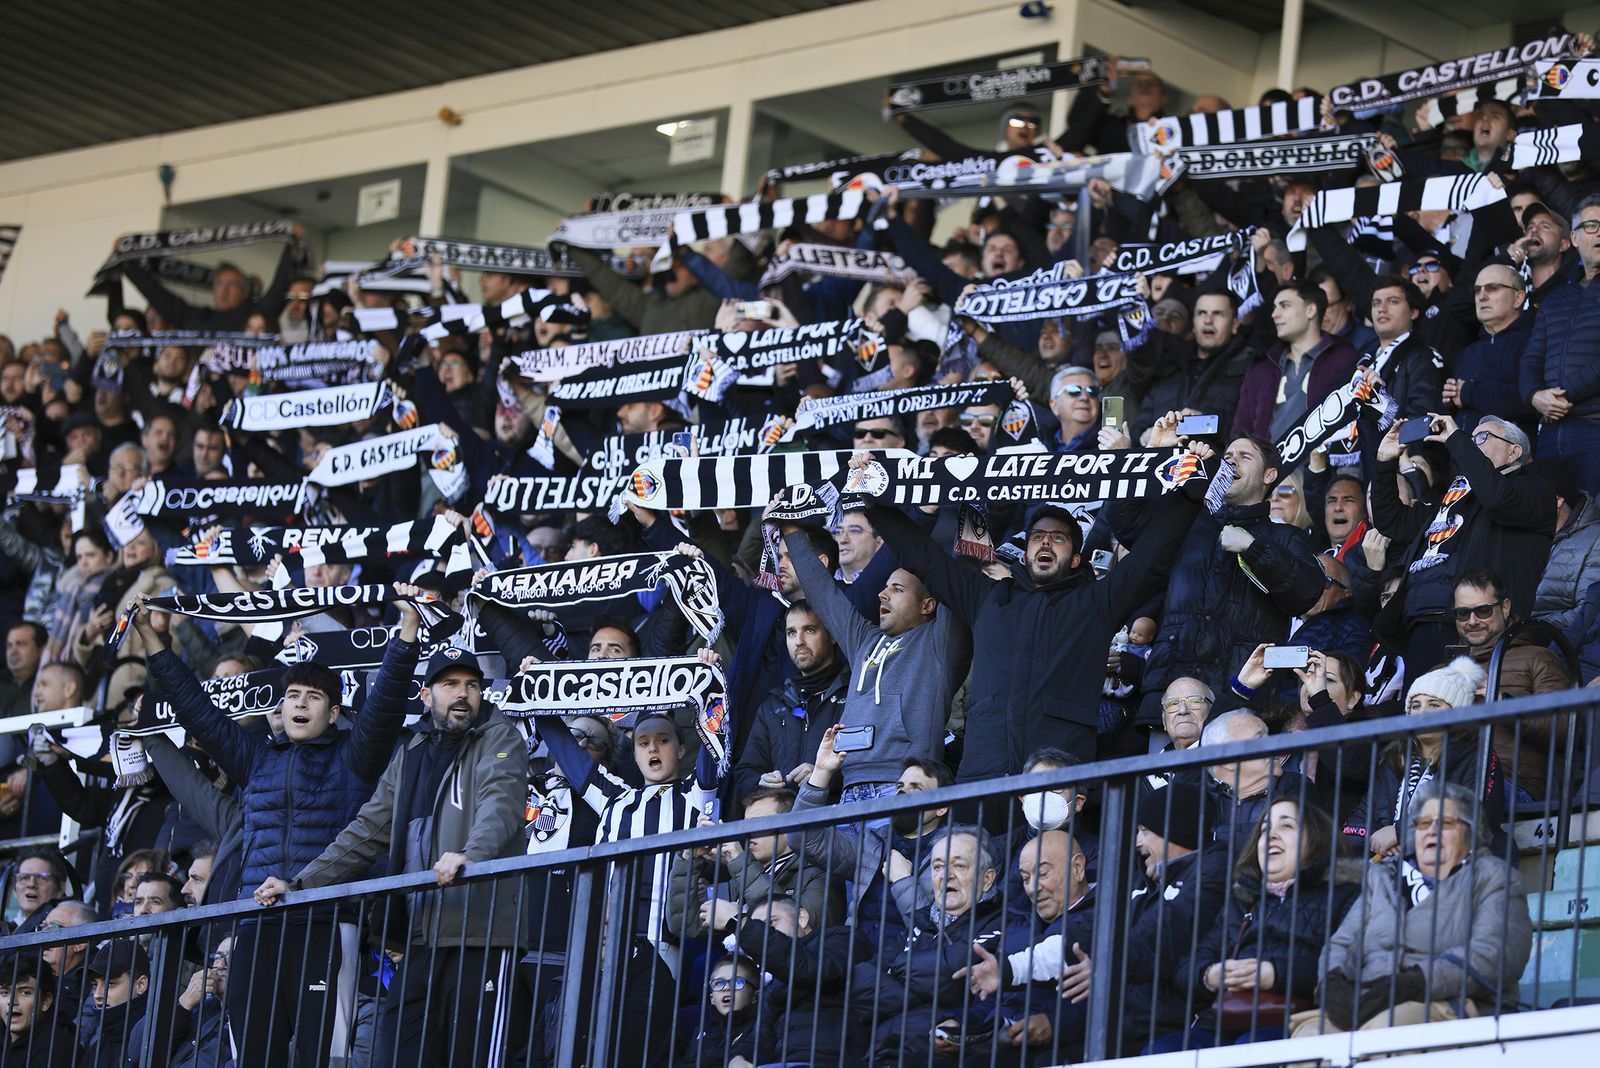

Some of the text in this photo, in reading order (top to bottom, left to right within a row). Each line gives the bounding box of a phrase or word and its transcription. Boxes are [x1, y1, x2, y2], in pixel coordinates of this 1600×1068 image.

[1332, 80, 1389, 105] C.D.
[1398, 34, 1571, 91] CASTELLON
[1117, 231, 1234, 271] C.D. CASTEL
[962, 281, 1088, 316] CASTELLO
[749, 327, 795, 348] LATE
[752, 339, 823, 368] CASTELLÓN
[580, 378, 615, 399] PAM
[615, 367, 683, 395] ORELLUT
[862, 401, 894, 419] PAM
[898, 389, 972, 413] ORELLUT
[897, 452, 1159, 479] MI LATE POR TI
[947, 478, 1091, 502] C.D. CASTELLÓN
